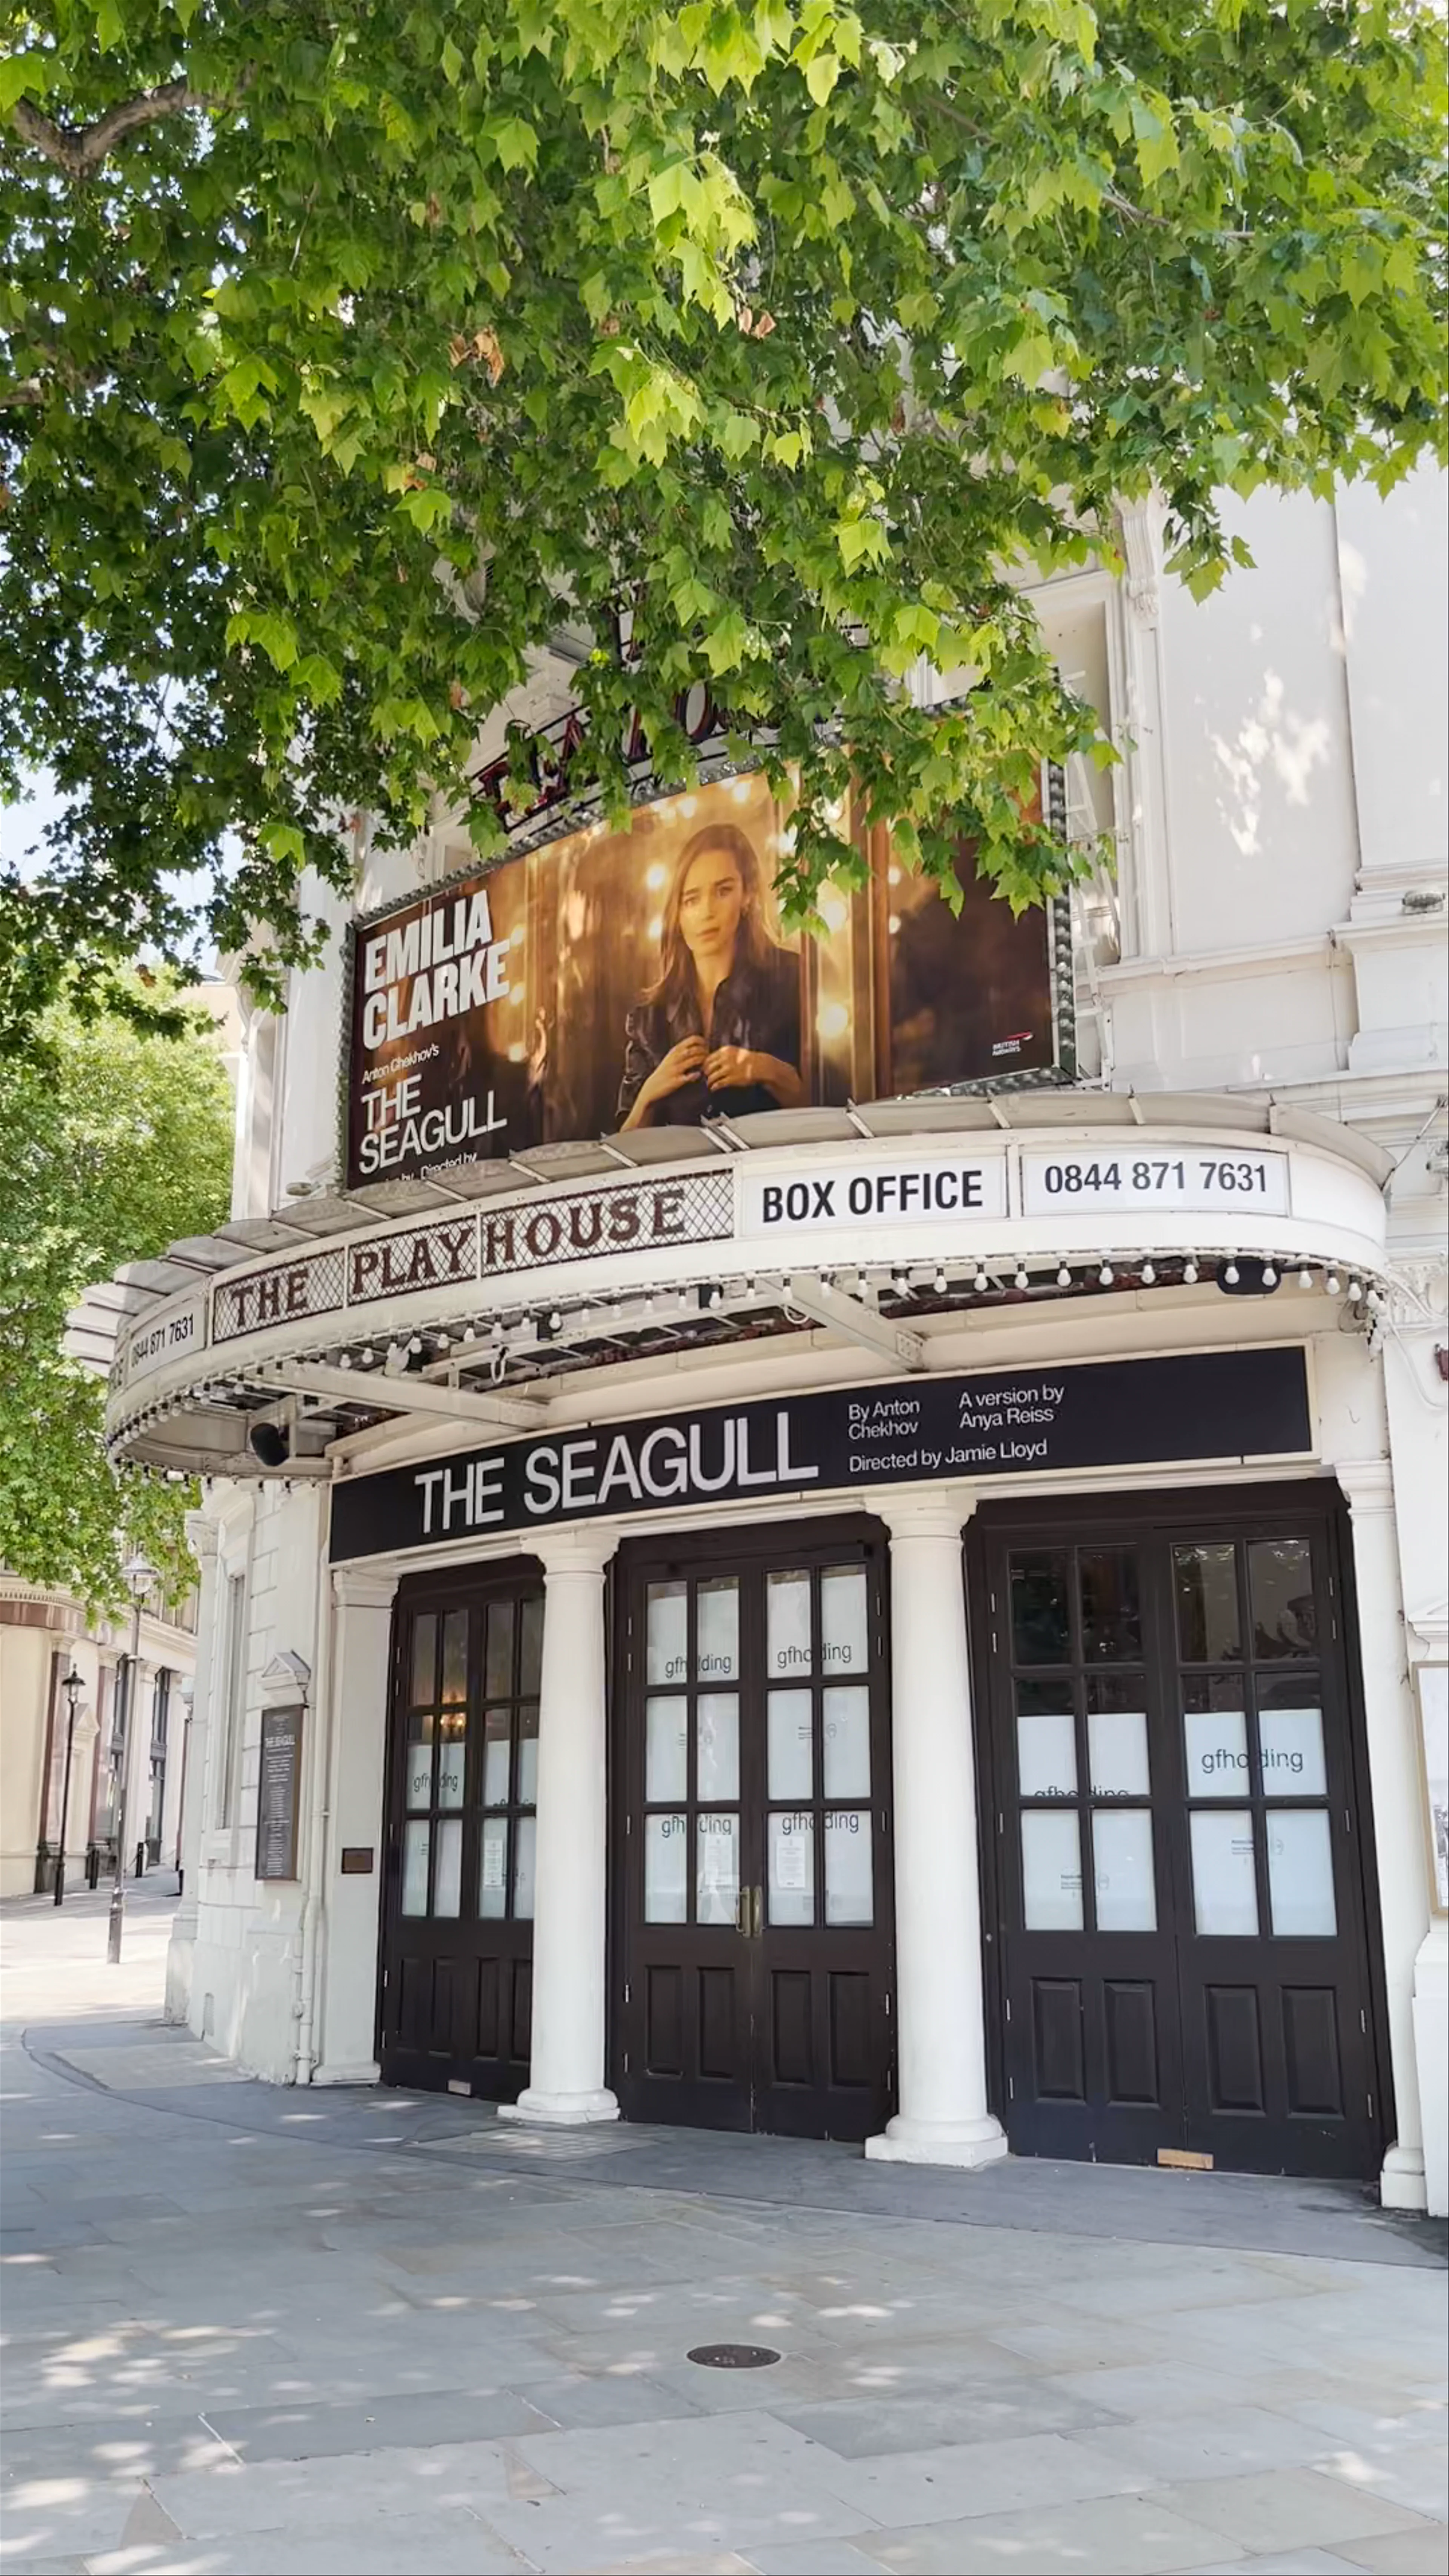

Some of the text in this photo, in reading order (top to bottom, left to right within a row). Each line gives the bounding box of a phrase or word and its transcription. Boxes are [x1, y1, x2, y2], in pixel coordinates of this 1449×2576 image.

[365, 889, 492, 995] EMILIA
[363, 938, 510, 1050] CLARKE
[361, 1043, 440, 1085] Anton Chekhov's
[361, 1073, 422, 1131] THE
[359, 1090, 508, 1174] SEAGULL
[763, 1170, 983, 1223] BOX OFFICE
[1044, 1161, 1266, 1193] 0844 871 7631
[231, 1269, 309, 1327] THE
[150, 1327, 165, 1355] 871
[169, 1312, 193, 1344] 7631
[849, 1399, 920, 1422] By Anton
[959, 1384, 1064, 1409] A version by
[849, 1421, 918, 1440] Chekhov
[959, 1407, 1054, 1431] Anya Reiss
[414, 1412, 819, 1533] THE SEAGULL
[850, 1438, 1048, 1472] Directed by Jamie Lloyd
[777, 1642, 852, 1669] gfhoding
[1201, 1748, 1303, 1774] gfhoding
